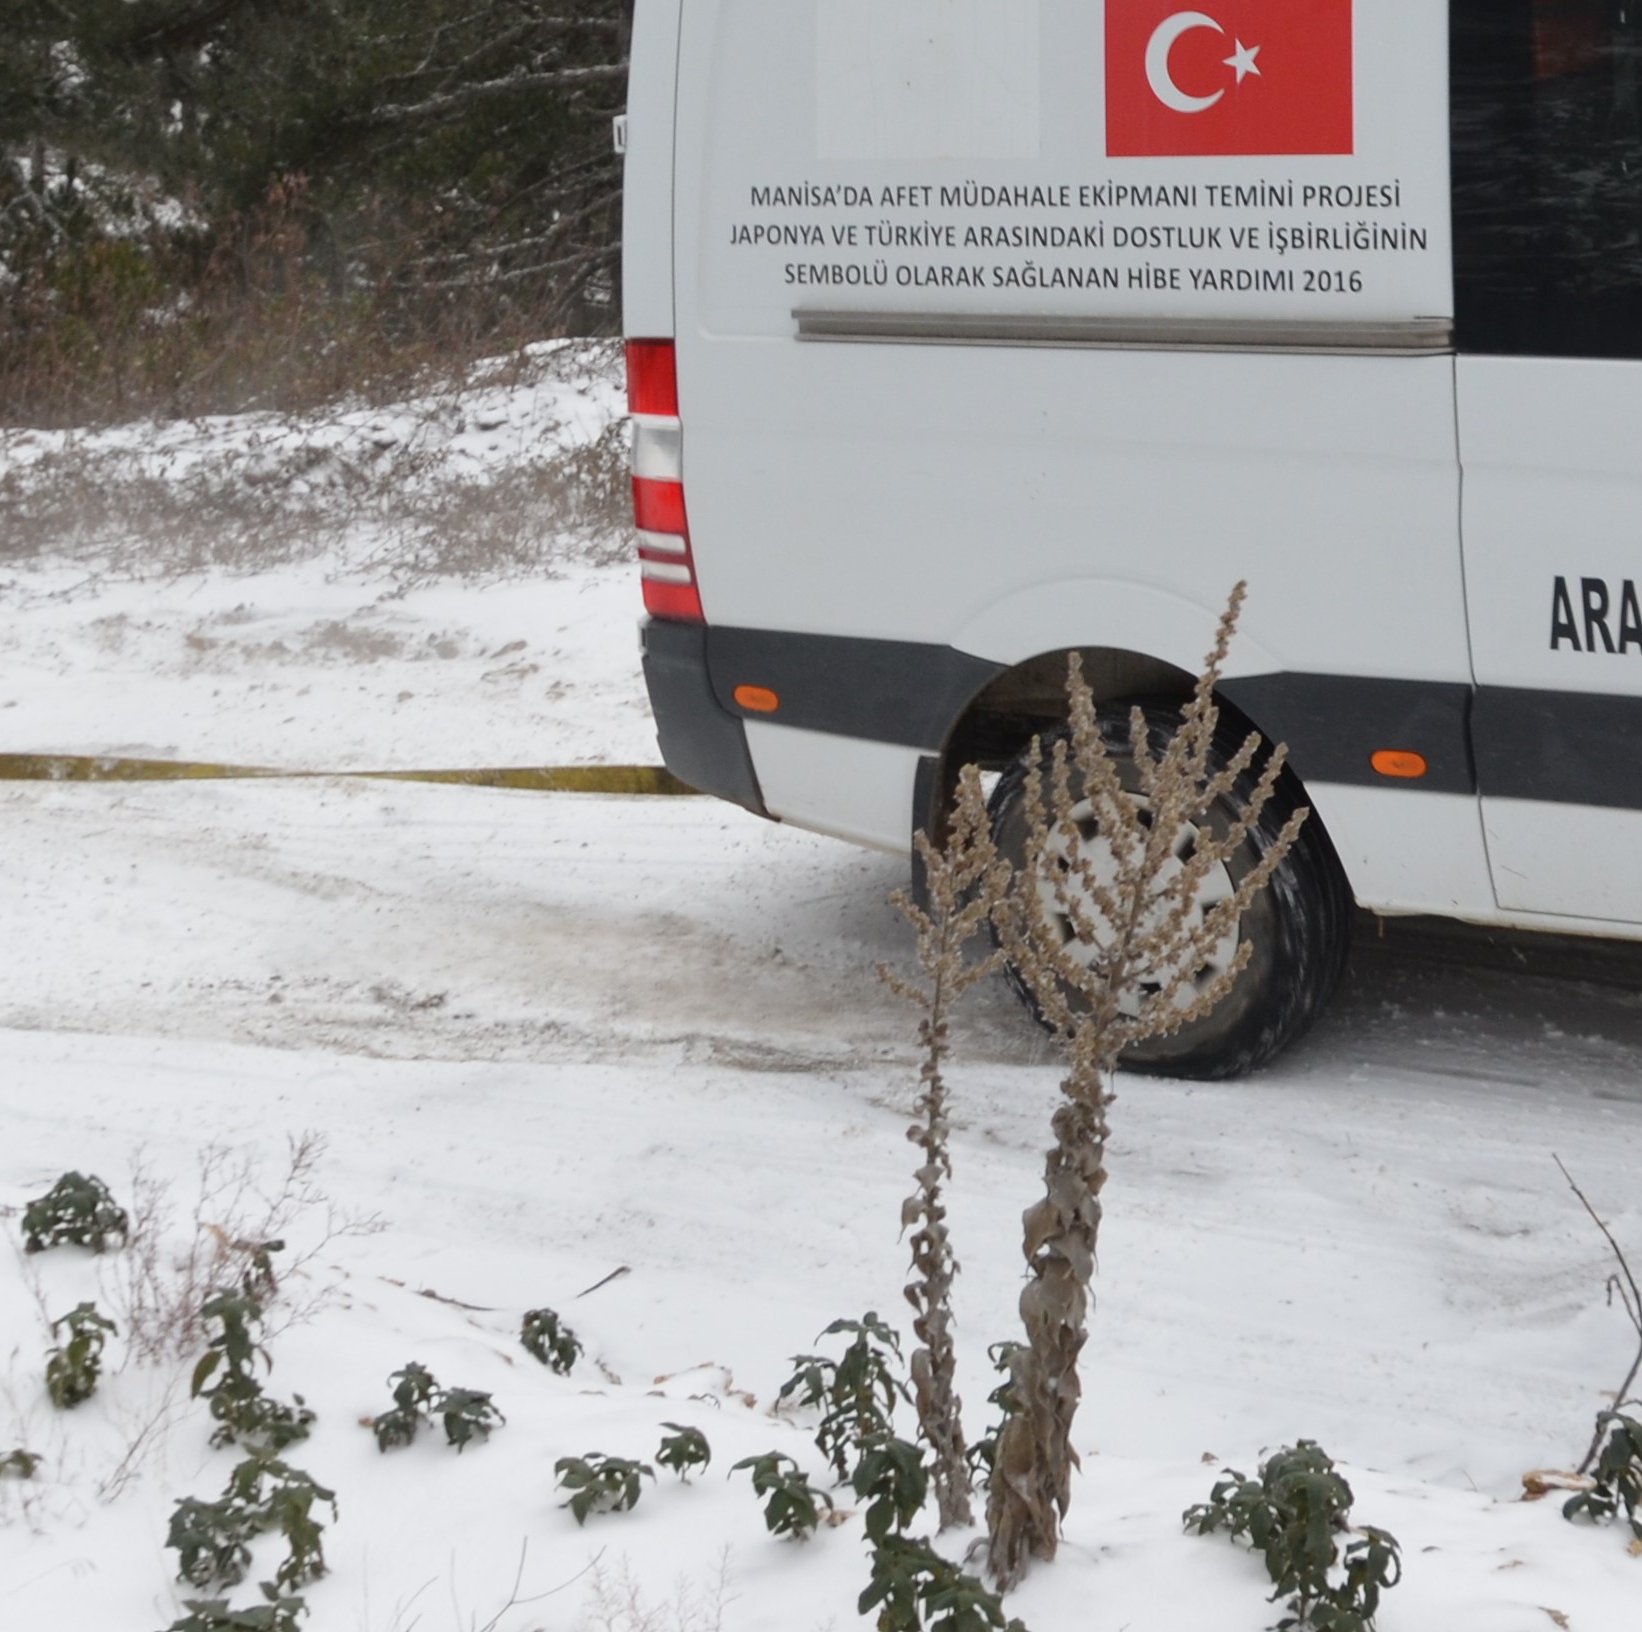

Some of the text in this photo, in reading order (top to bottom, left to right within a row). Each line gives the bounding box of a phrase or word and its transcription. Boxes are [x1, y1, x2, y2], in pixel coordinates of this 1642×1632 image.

[880, 185, 933, 207] AFET
[940, 180, 1071, 207] MÜDAHALE
[1079, 179, 1197, 207] EKİPMANI
[1204, 179, 1293, 207] TEMİNİ
[1303, 179, 1401, 208] PROJESİ
[730, 220, 1427, 256] JAPONYA VE TÜRKİYE ARASINDAKİ DOSTLUK VE İŞBİRLİĞİNİN
[784, 259, 1363, 293] SEMBOLÜ OLARAK SAĞLANAN HİBE YARDIMI 2016
